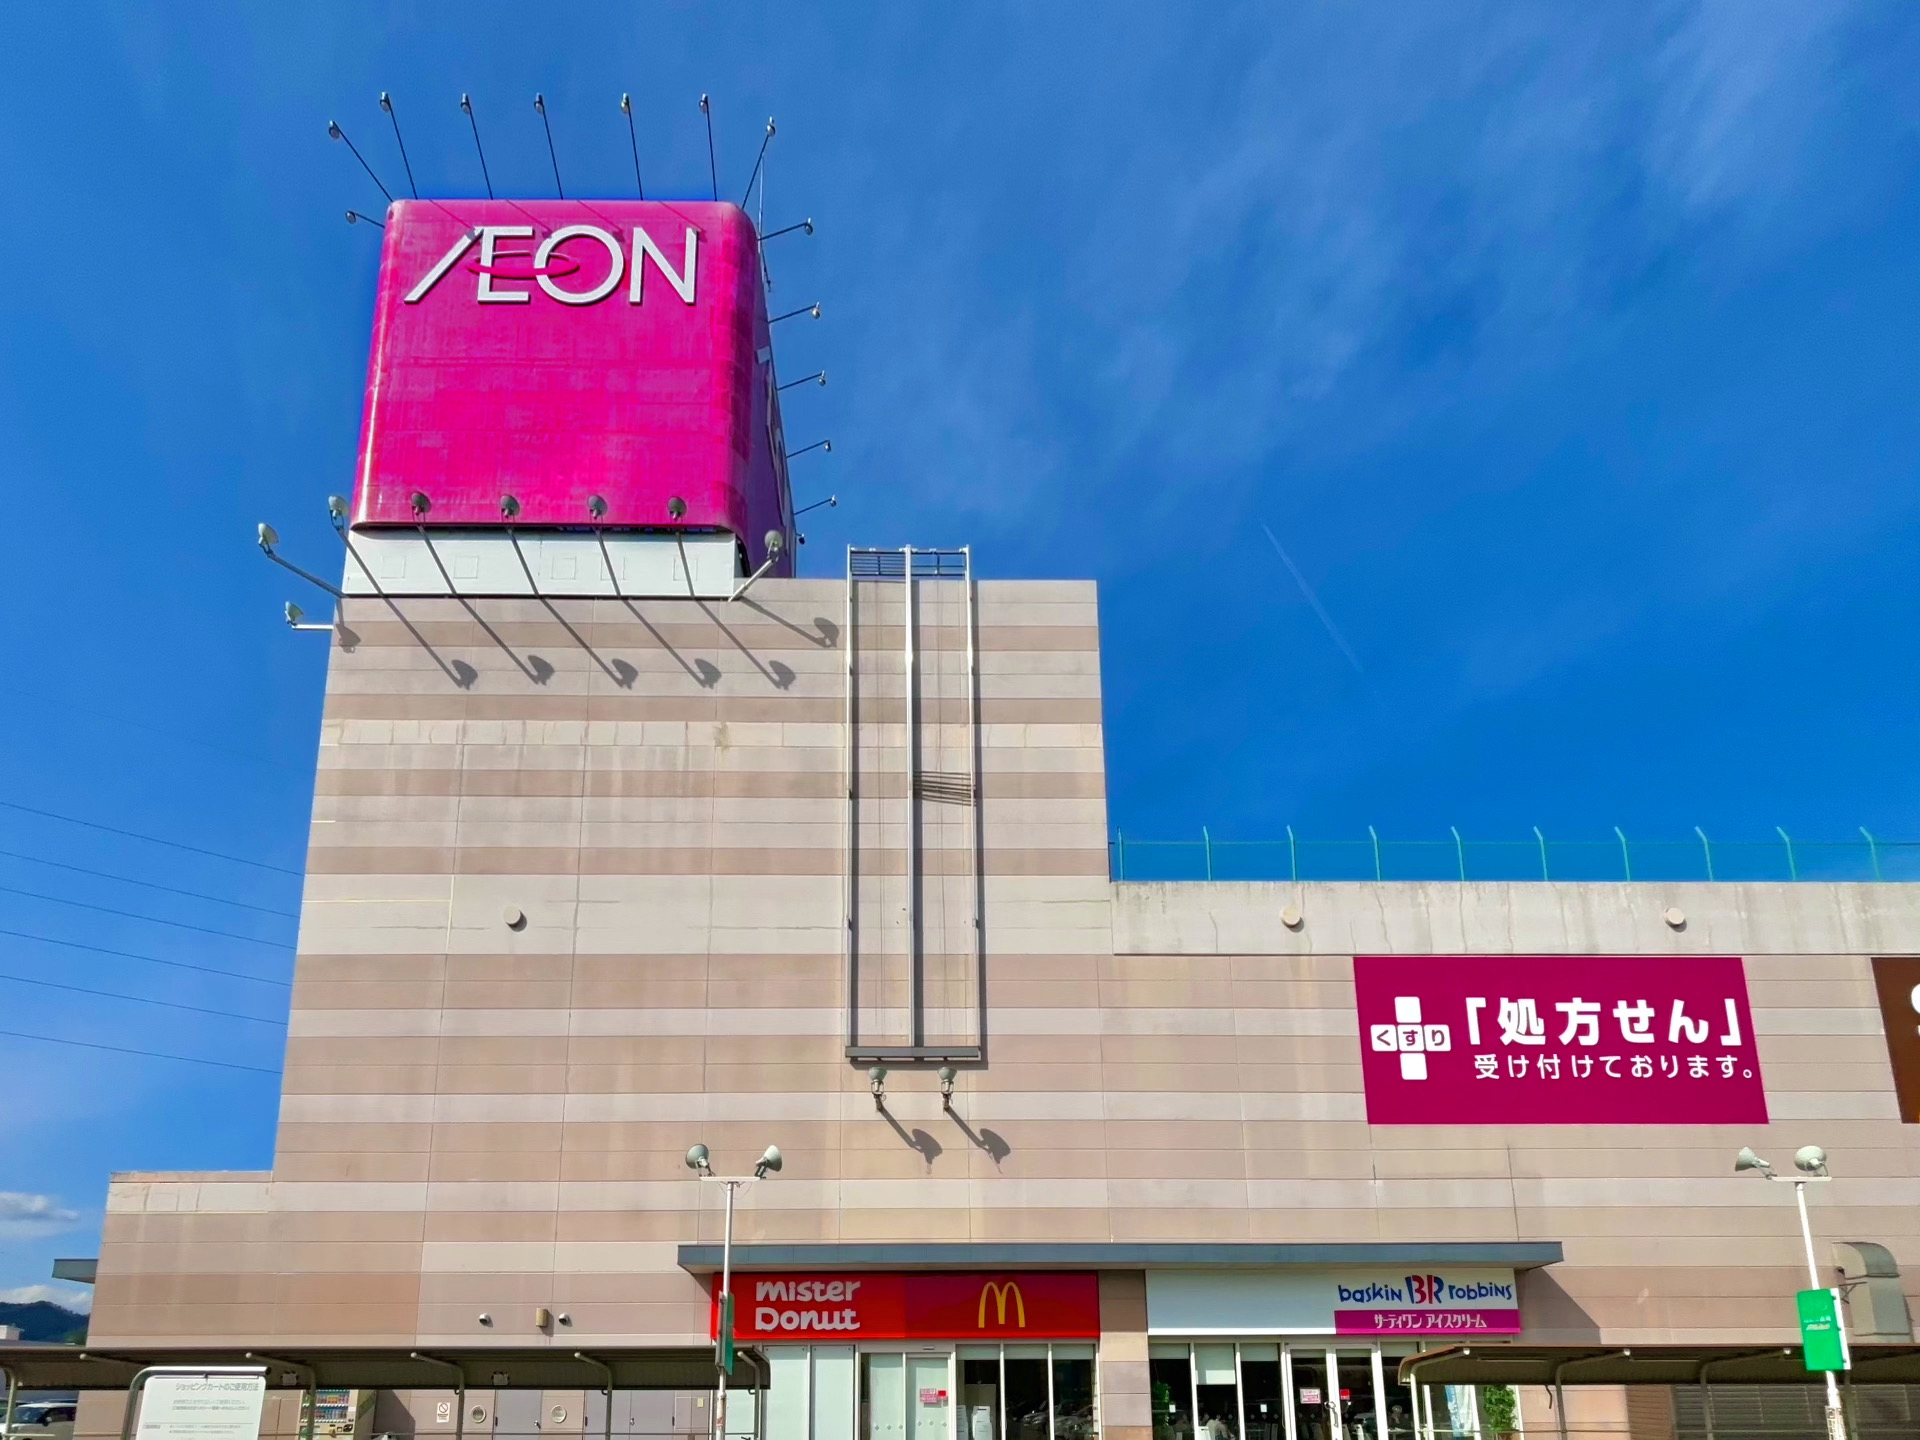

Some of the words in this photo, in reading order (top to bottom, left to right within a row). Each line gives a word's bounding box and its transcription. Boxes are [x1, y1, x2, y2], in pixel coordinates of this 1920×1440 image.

[1465, 997, 1743, 1047] 「処方せん」
[1376, 1028, 1447, 1047] くすり
[1473, 1054, 1753, 1080] 受け付けております。
[1405, 1275, 1444, 1304] BR
[755, 1307, 860, 1332] Donut
[1374, 1314, 1422, 1329] サーティワン
[1425, 1314, 1487, 1329] アイスクリーム
